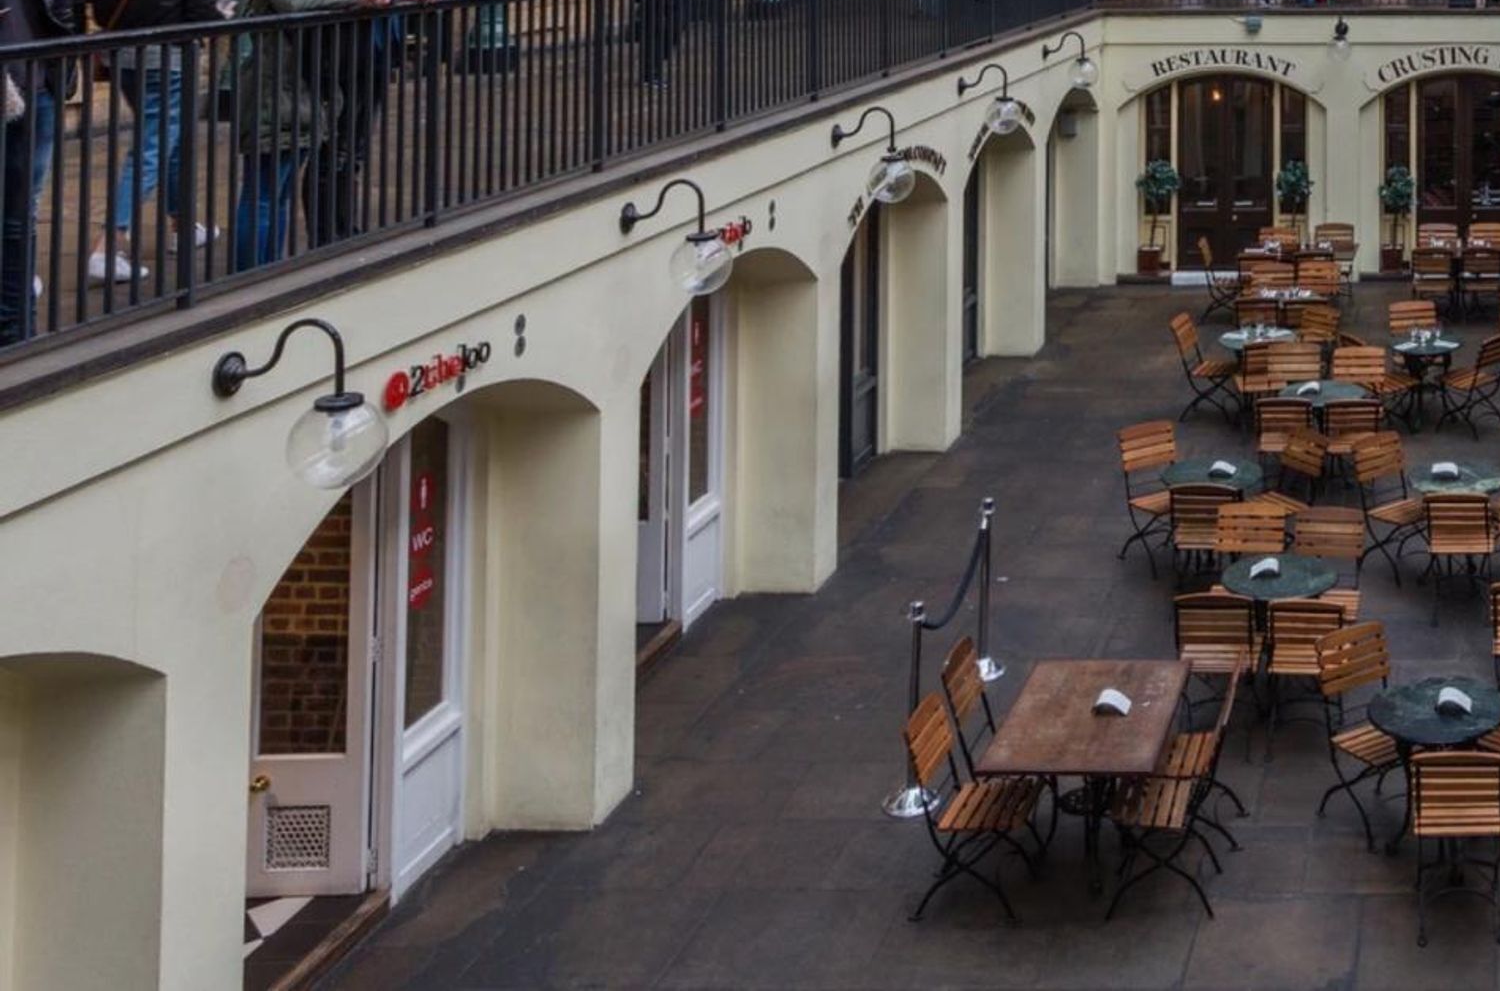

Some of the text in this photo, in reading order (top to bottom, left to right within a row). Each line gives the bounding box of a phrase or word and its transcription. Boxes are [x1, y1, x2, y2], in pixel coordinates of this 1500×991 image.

[1151, 49, 1296, 77] RESTAURANT
[1377, 46, 1489, 83] CRUSTING
[412, 526, 433, 551] WC
